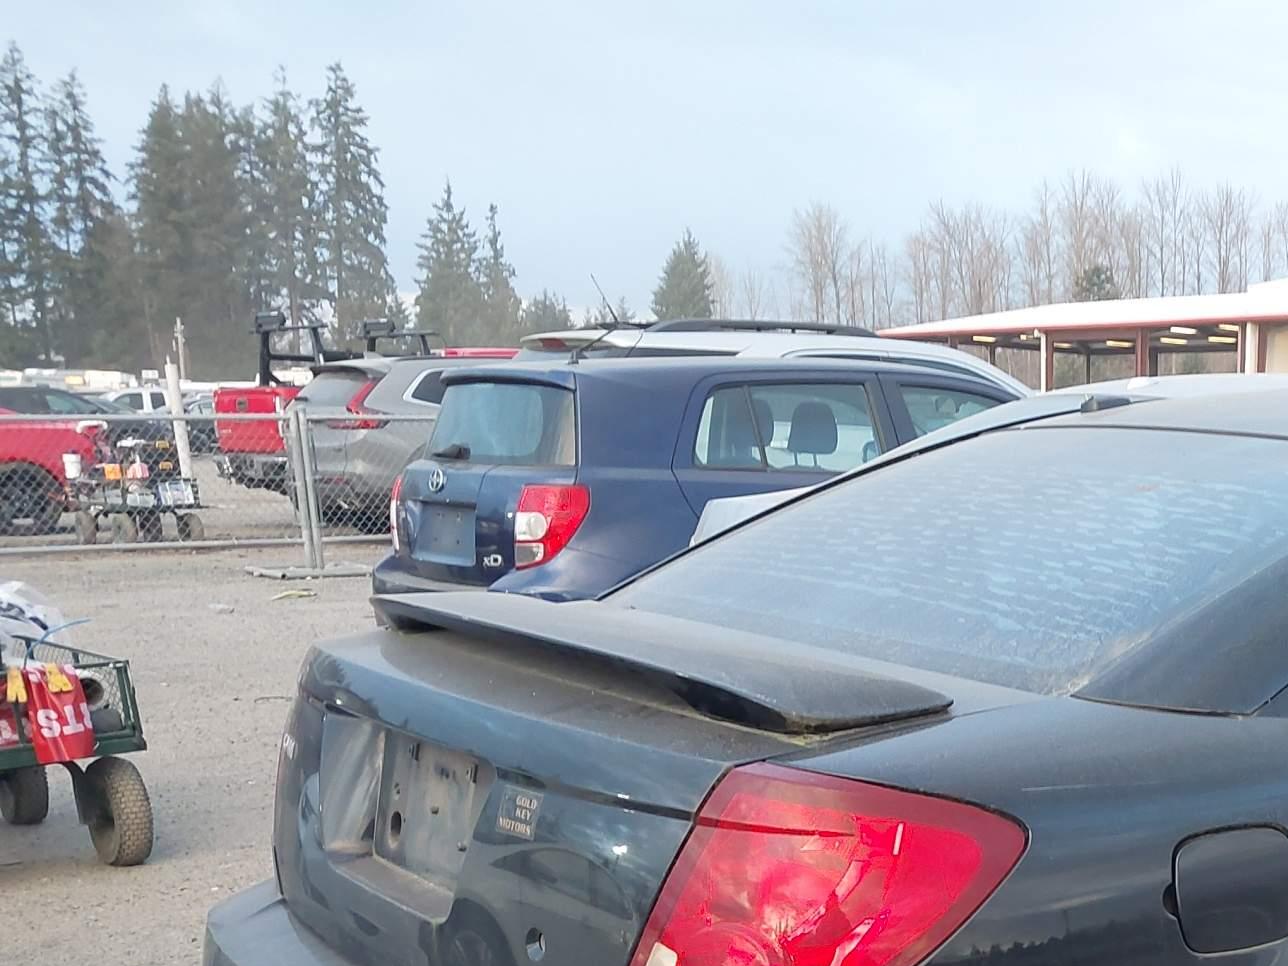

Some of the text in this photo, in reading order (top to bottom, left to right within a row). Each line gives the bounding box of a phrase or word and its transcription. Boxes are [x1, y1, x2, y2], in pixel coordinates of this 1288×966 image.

[482, 554, 503, 568] xD
[515, 794, 538, 809] GOLD
[515, 807, 533, 822] KEY
[498, 816, 532, 835] MOTORS
